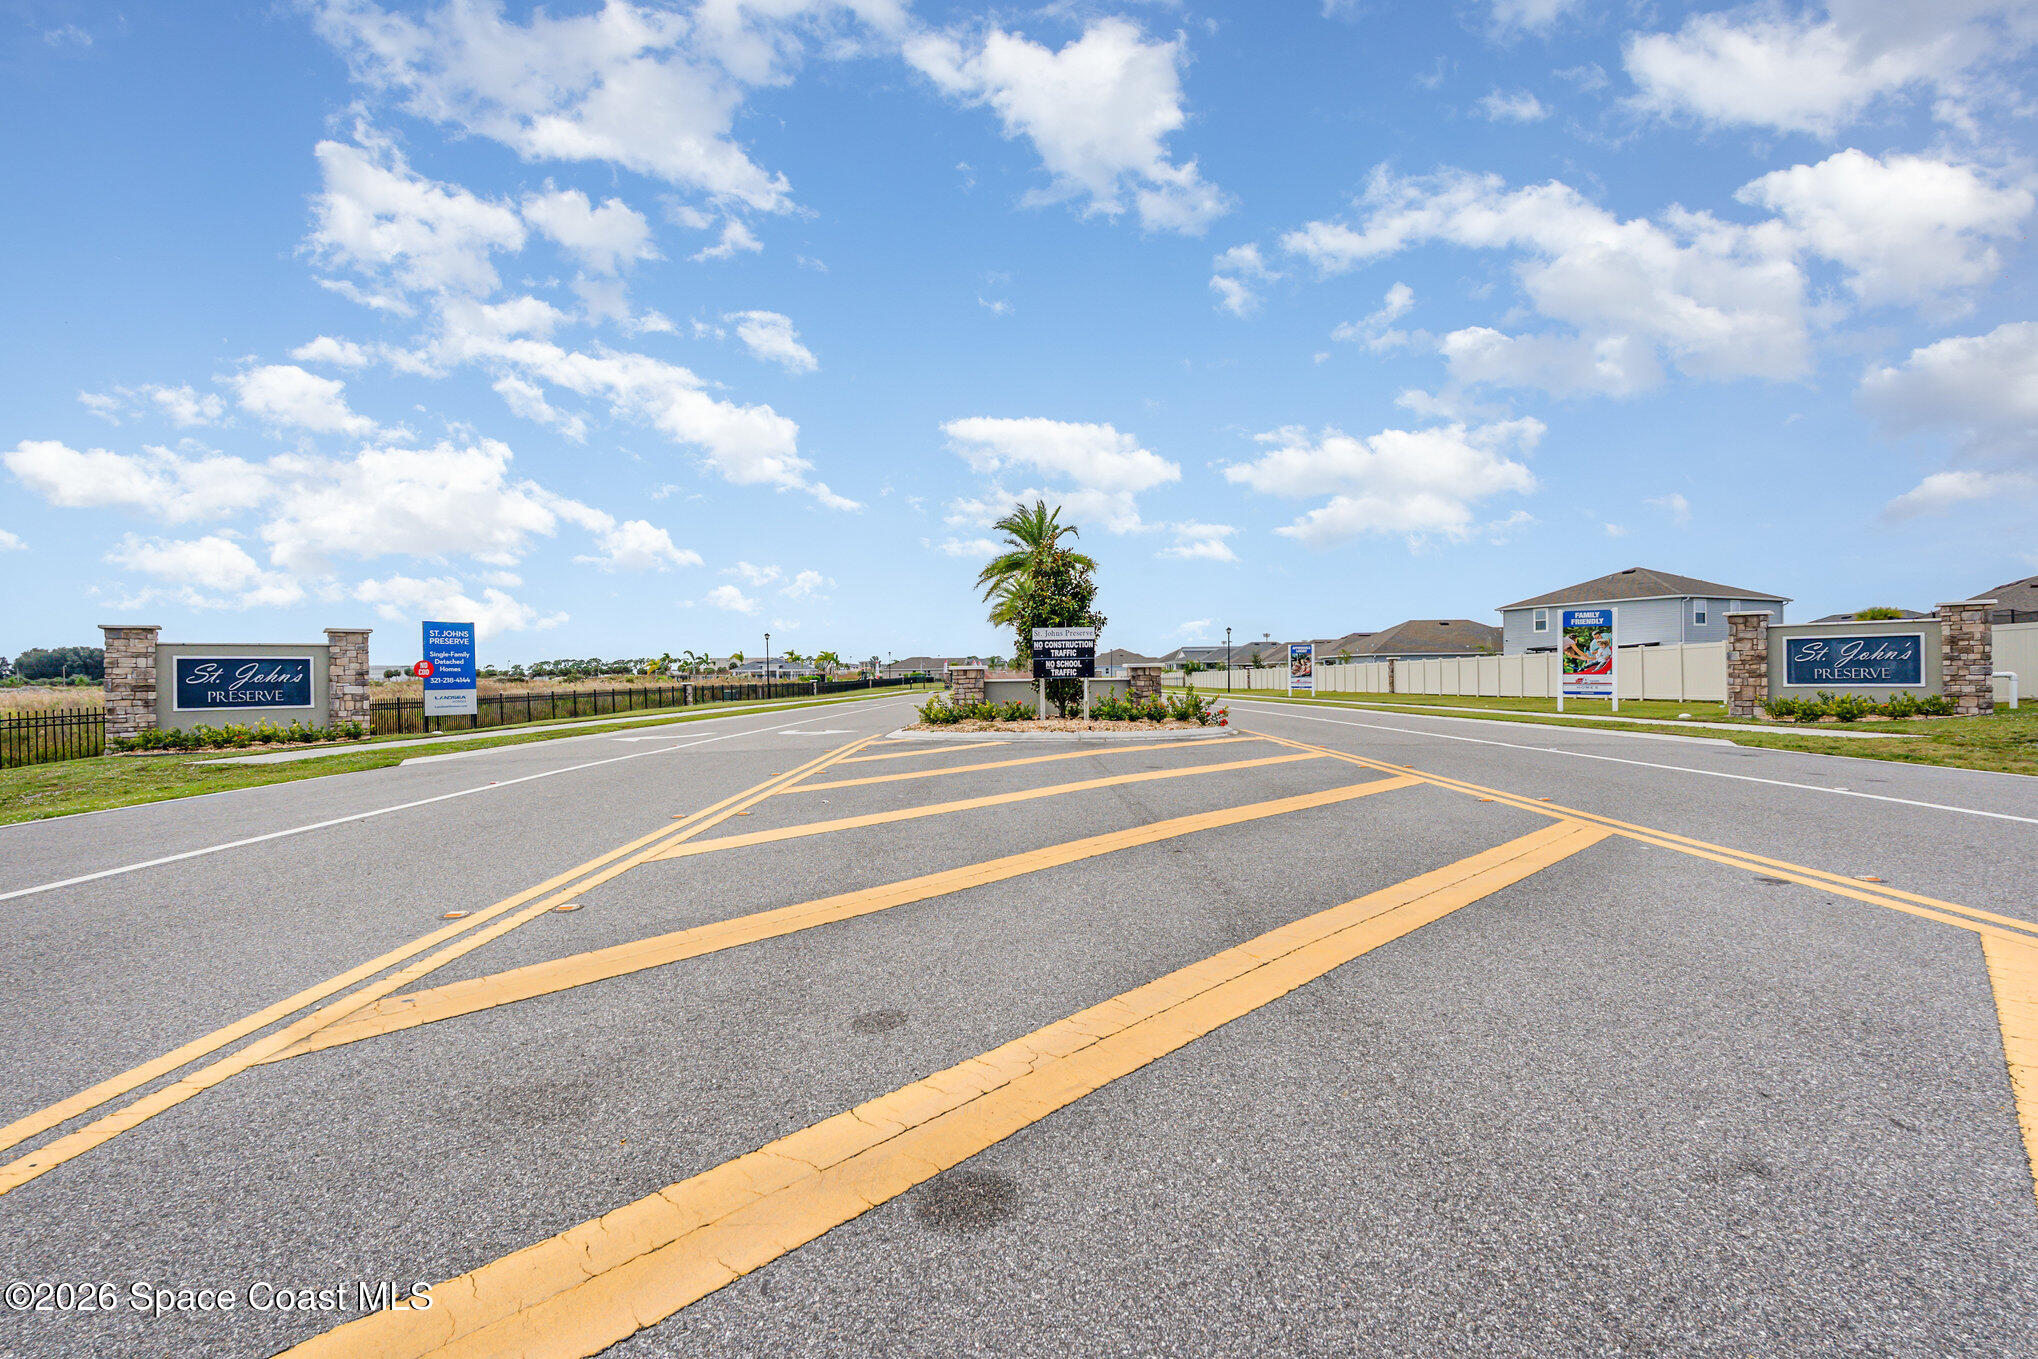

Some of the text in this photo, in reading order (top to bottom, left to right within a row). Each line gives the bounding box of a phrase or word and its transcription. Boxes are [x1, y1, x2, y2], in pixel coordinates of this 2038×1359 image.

[1794, 640, 1912, 668] St. John's
[185, 662, 303, 690] St. John's
[1814, 667, 1891, 679] PRESERVE
[207, 690, 284, 702] PRESERVE
